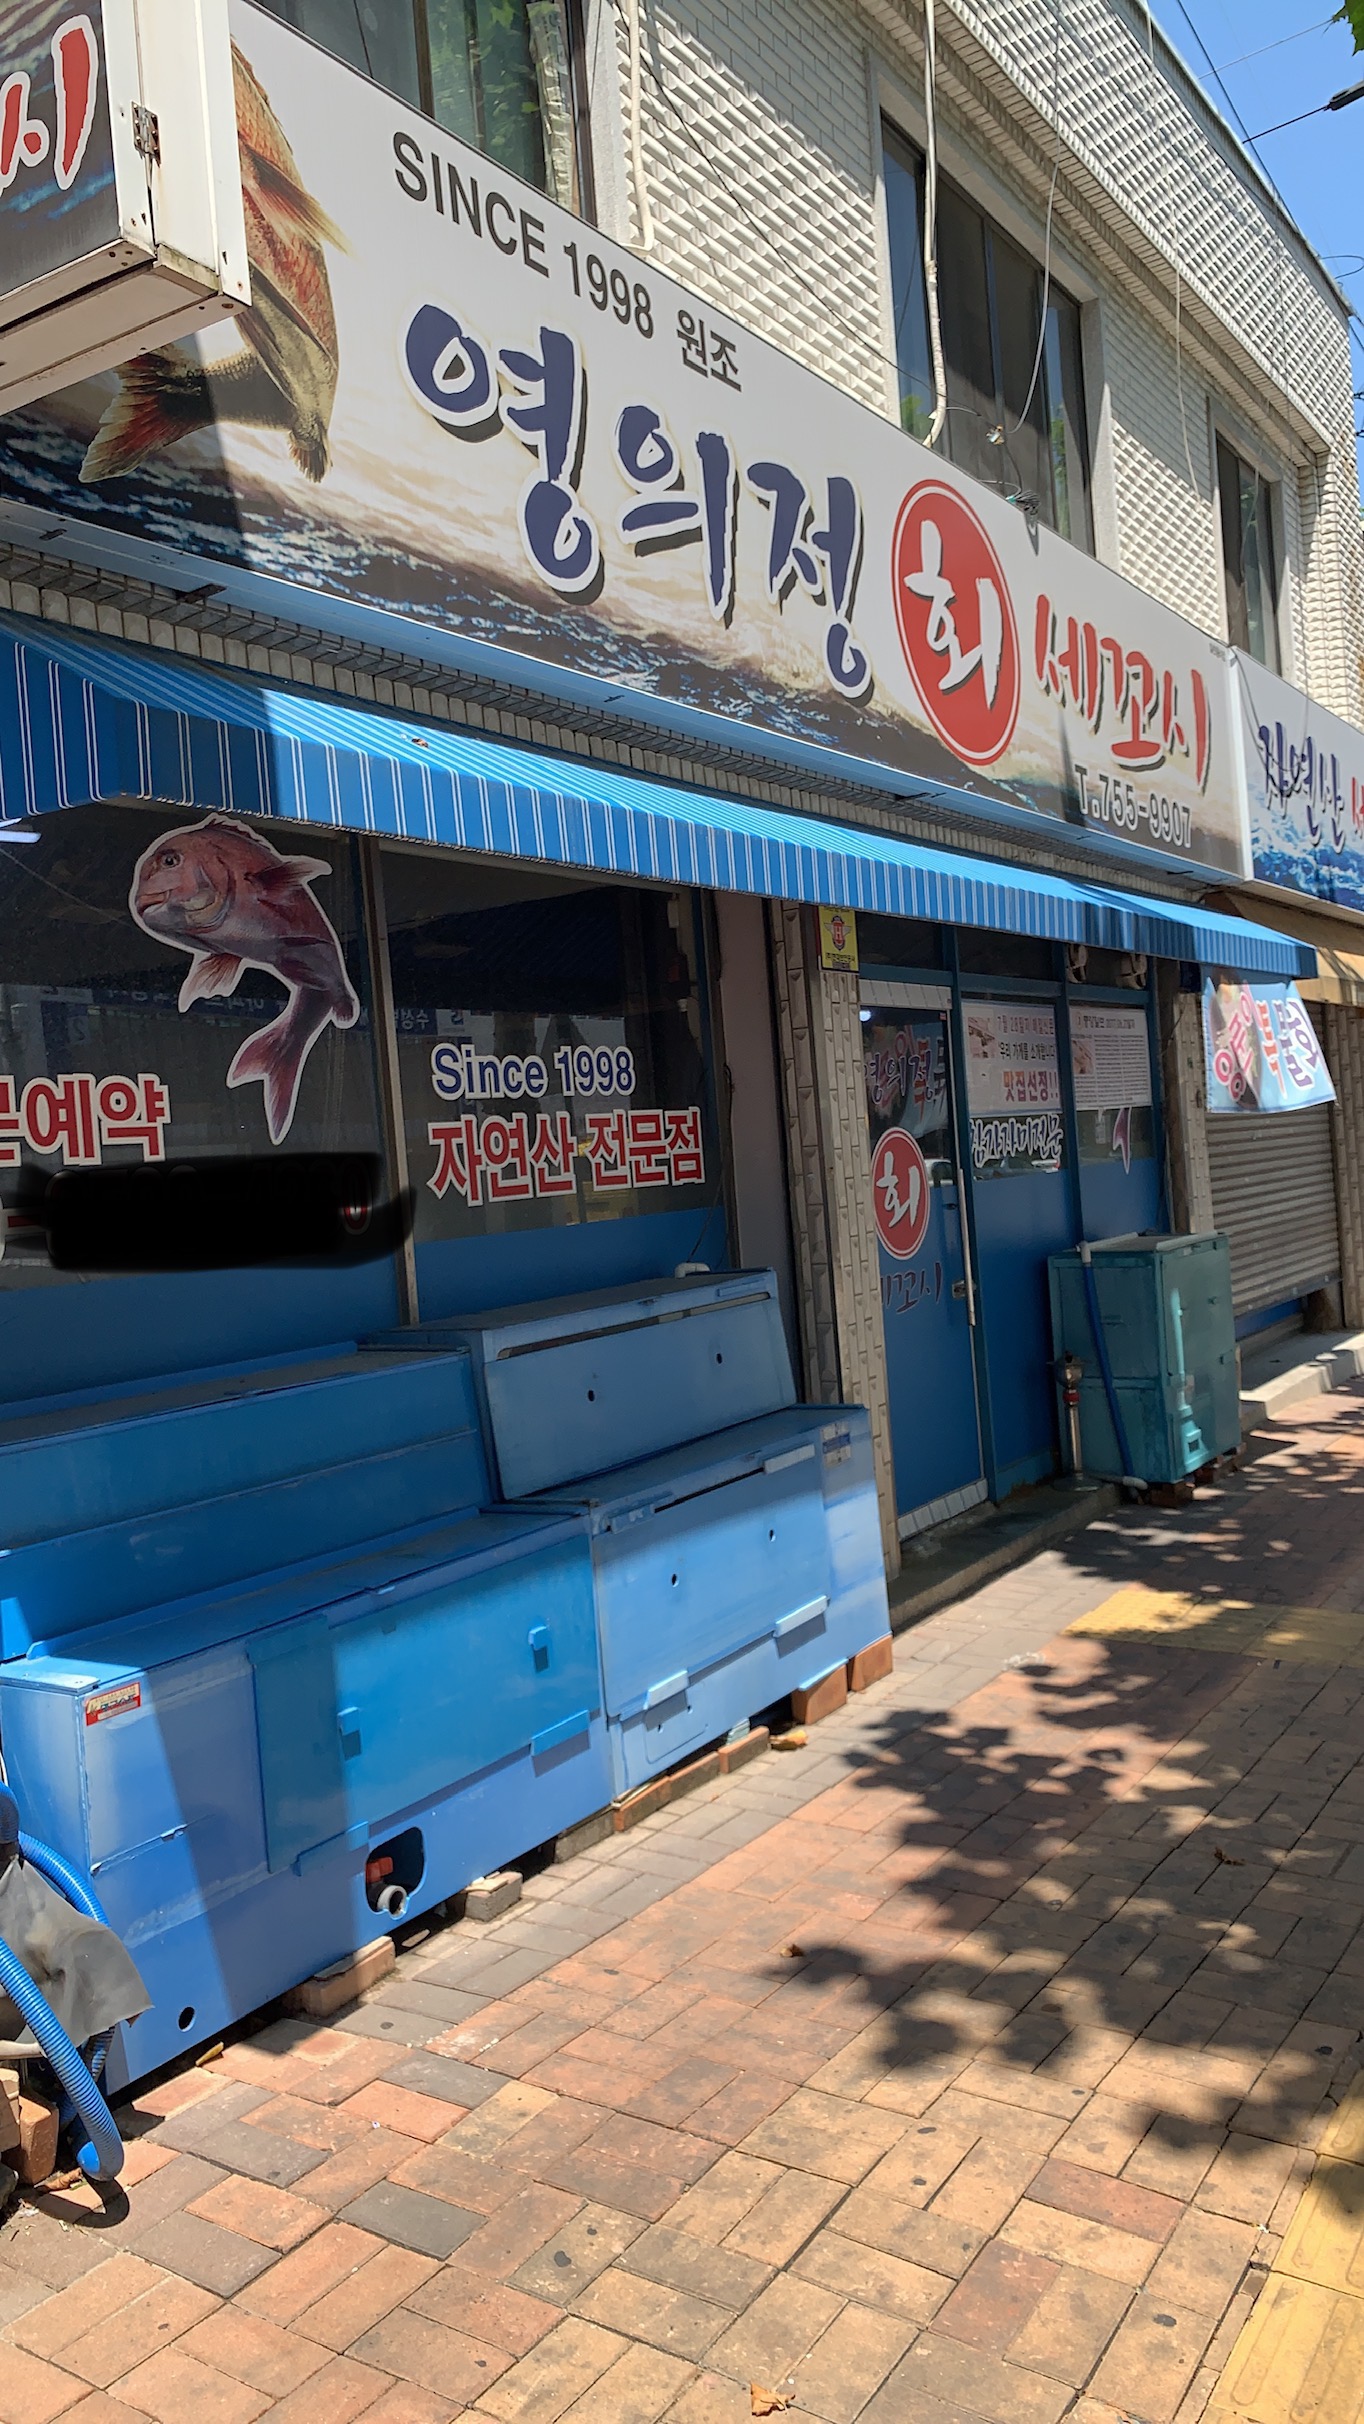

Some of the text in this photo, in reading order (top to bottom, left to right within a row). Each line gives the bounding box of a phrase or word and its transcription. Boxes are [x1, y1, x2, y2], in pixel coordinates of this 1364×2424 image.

[393, 131, 742, 392] SINCE 1998 원조
[403, 301, 1209, 788] 영의정 회 세꼬시
[1073, 764, 1193, 849] T.755-9907
[431, 1044, 636, 1100] Since 1998
[1003, 1070, 1059, 1102] 맛집선정!!
[427, 1107, 705, 1207] 자연산 전문점
[875, 1150, 921, 1229] 회
